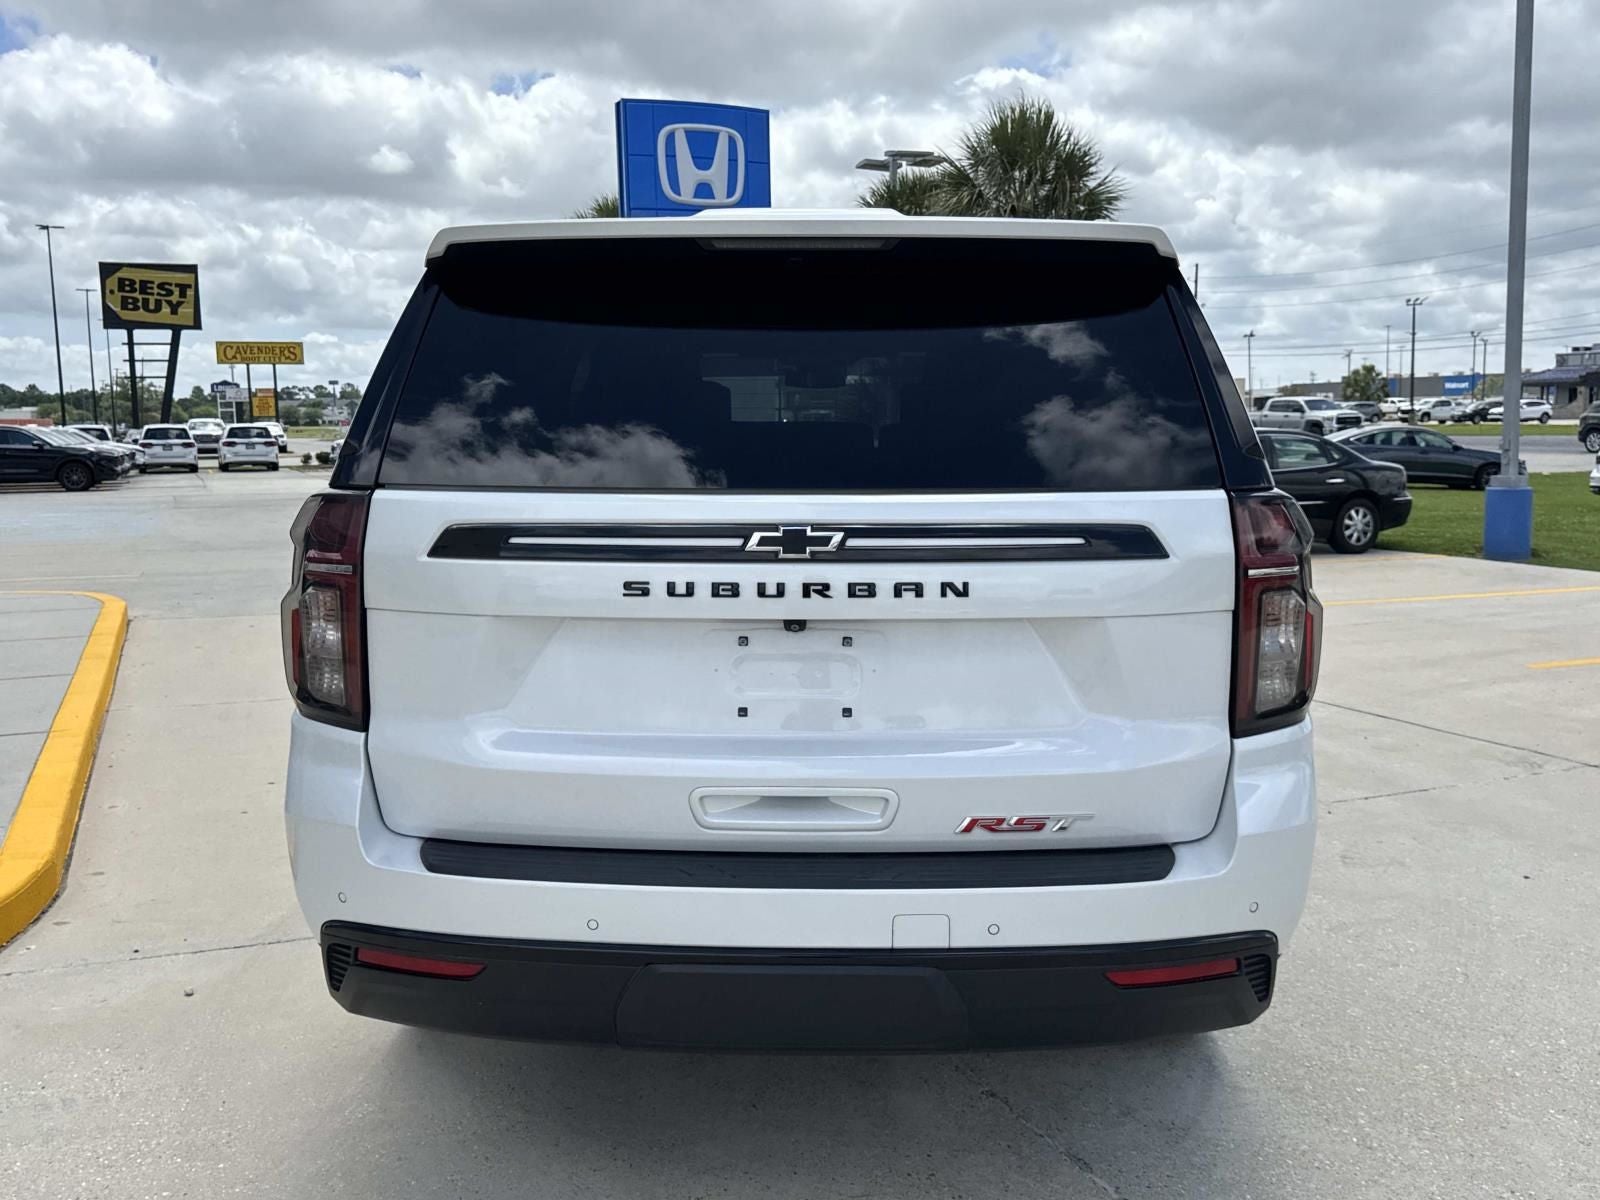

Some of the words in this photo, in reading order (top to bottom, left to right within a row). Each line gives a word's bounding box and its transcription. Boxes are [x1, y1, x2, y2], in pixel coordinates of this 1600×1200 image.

[117, 277, 193, 299] BEST
[120, 295, 186, 316] BUY
[223, 344, 298, 361] CAVENDER'S
[622, 580, 970, 599] SUBURBAN
[954, 814, 1096, 834] RST
